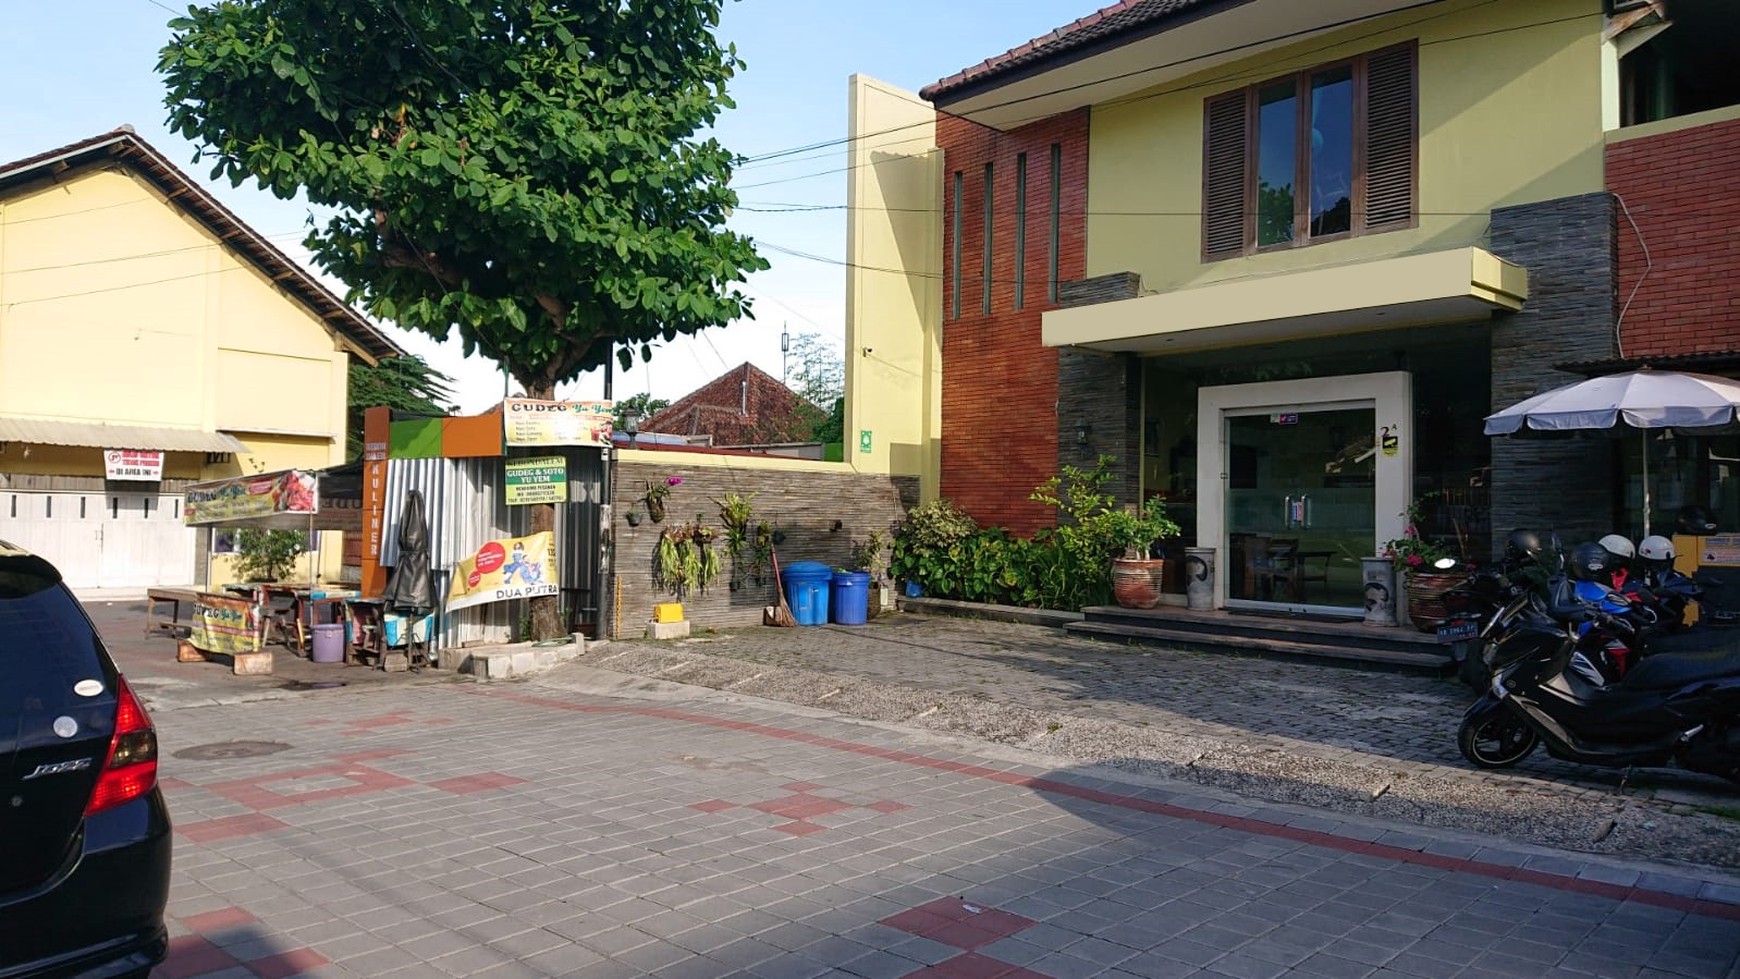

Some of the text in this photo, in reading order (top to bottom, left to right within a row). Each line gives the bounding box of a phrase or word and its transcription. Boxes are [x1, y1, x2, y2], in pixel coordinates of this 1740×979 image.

[511, 403, 567, 412] GUDEG
[507, 469, 534, 477] GUDEG
[371, 464, 379, 556] KULINER
[496, 590, 522, 599] DUA
